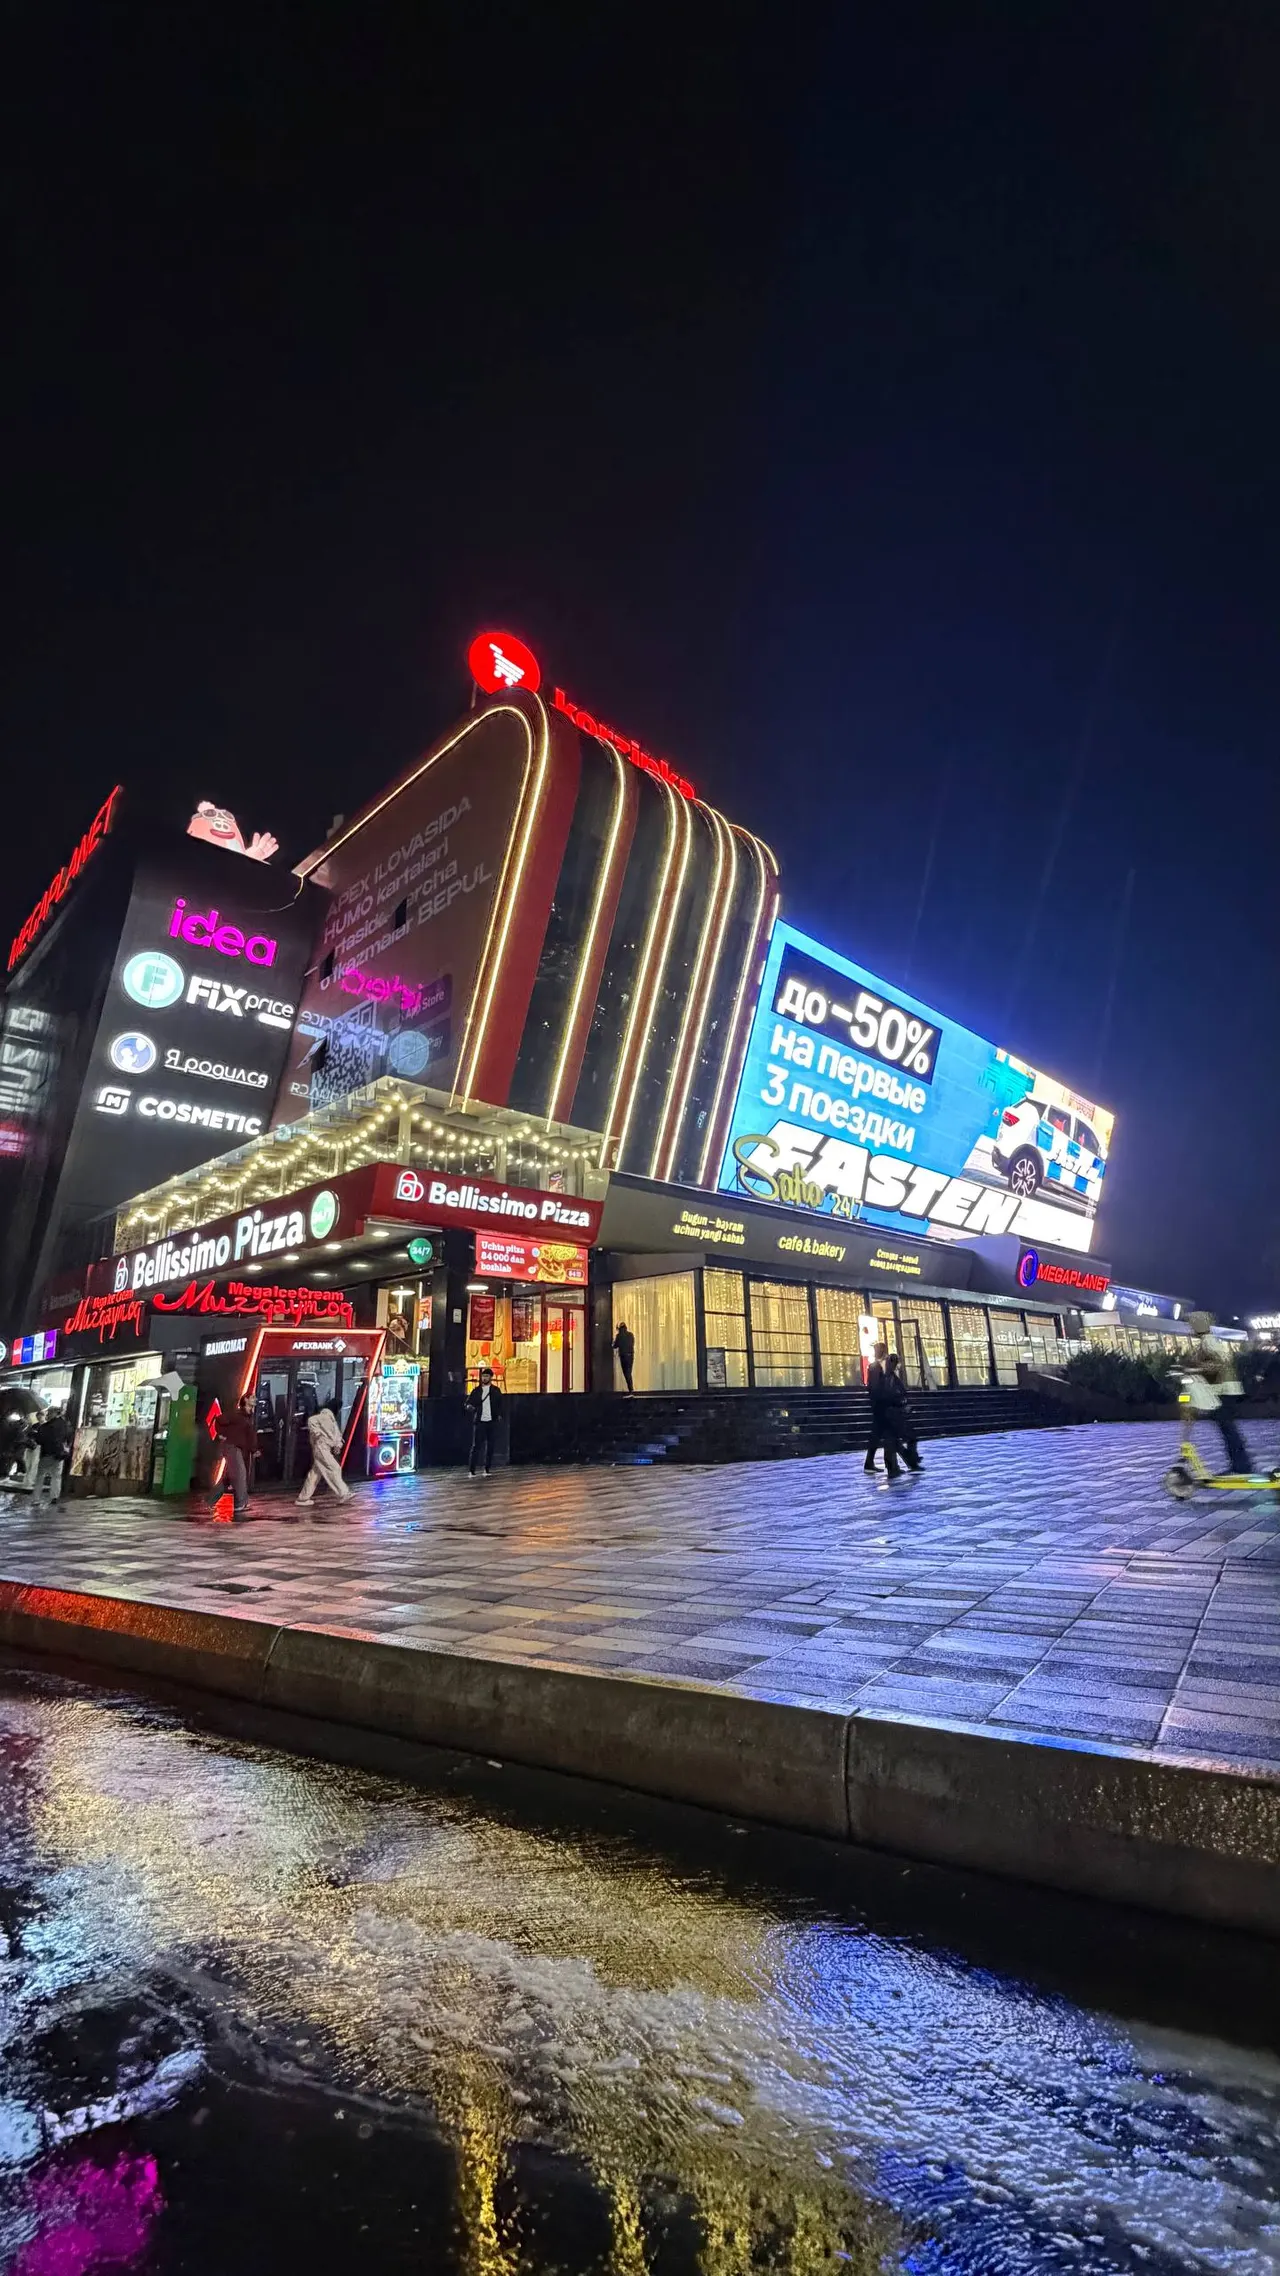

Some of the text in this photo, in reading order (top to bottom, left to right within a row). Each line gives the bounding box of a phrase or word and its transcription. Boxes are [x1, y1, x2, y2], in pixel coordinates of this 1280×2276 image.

[555, 687, 695, 800] korzinka
[417, 861, 494, 926] BEPUL
[169, 898, 277, 967] idea
[323, 895, 375, 945] HUMO
[245, 994, 294, 1018] price
[776, 978, 828, 1024] до
[164, 1049, 269, 1089] Я родился
[770, 1024, 927, 1114] на первые
[138, 1097, 262, 1136] COSMETIC
[760, 1063, 916, 1153] 3 поездки
[744, 1118, 1023, 1238] FASTEN
[429, 1181, 590, 1227] Bellissimo Pizza
[830, 1193, 864, 1220] 24/7
[132, 1209, 306, 1290] Bellissimo Pizza
[412, 1245, 431, 1257] 24/7
[481, 1240, 505, 1252] Uchta
[1037, 1263, 1110, 1293] MEGAPLANET
[205, 1337, 248, 1357] BANKOMAT
[292, 1341, 334, 1351] APEXBANK
